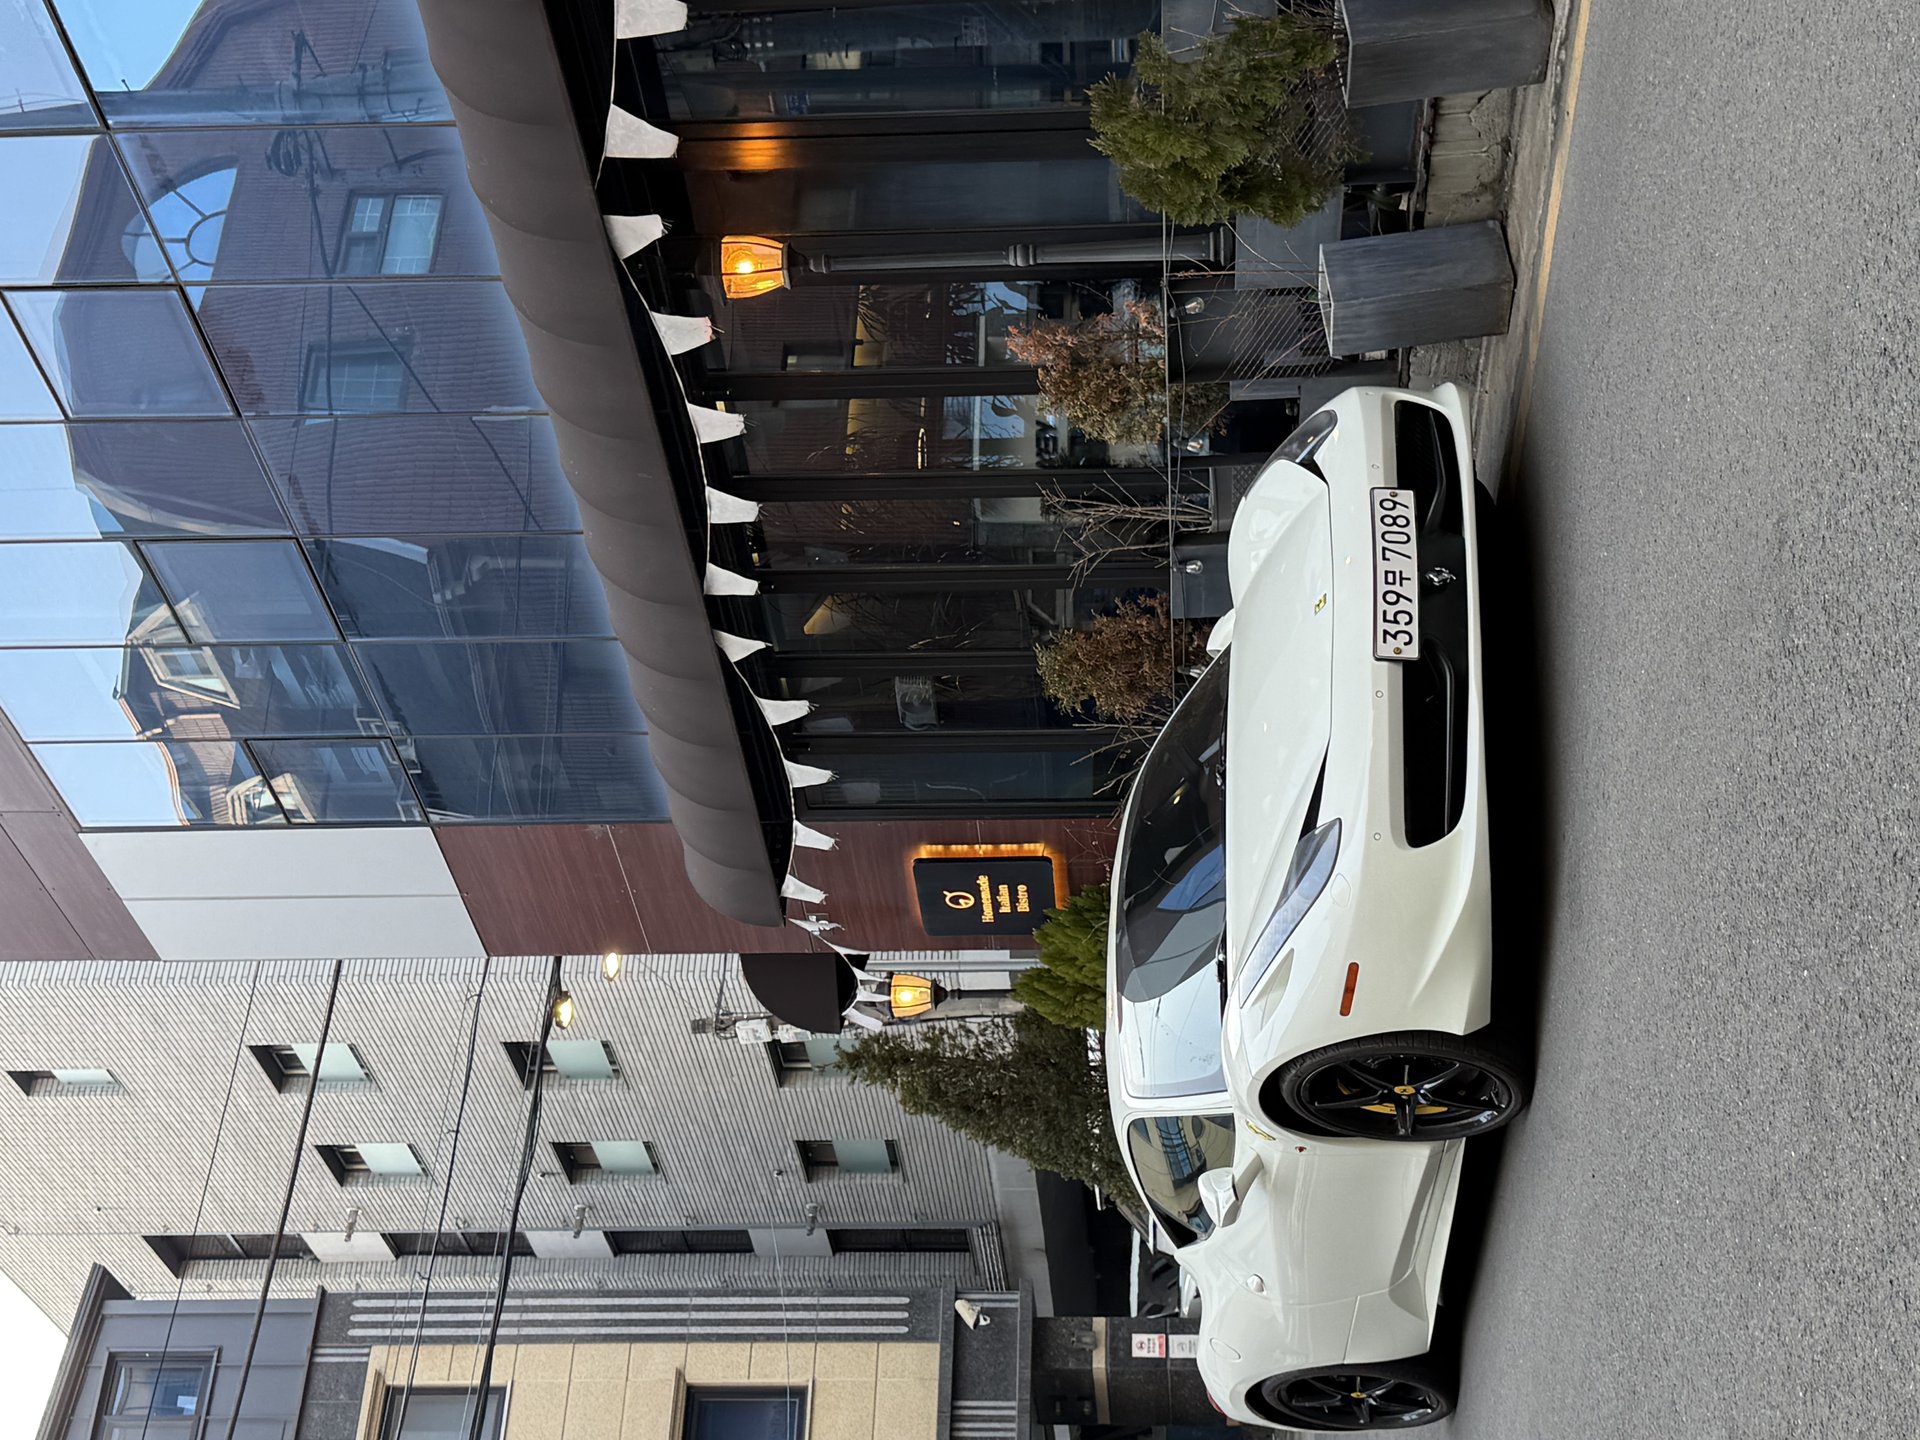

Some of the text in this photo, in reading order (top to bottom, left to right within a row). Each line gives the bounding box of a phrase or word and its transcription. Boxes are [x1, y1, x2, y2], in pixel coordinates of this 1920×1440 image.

[1379, 498, 1413, 647] 359무 7089
[976, 874, 995, 923] Homemade
[996, 884, 1011, 913] Italian
[1016, 884, 1030, 912] Bistro
